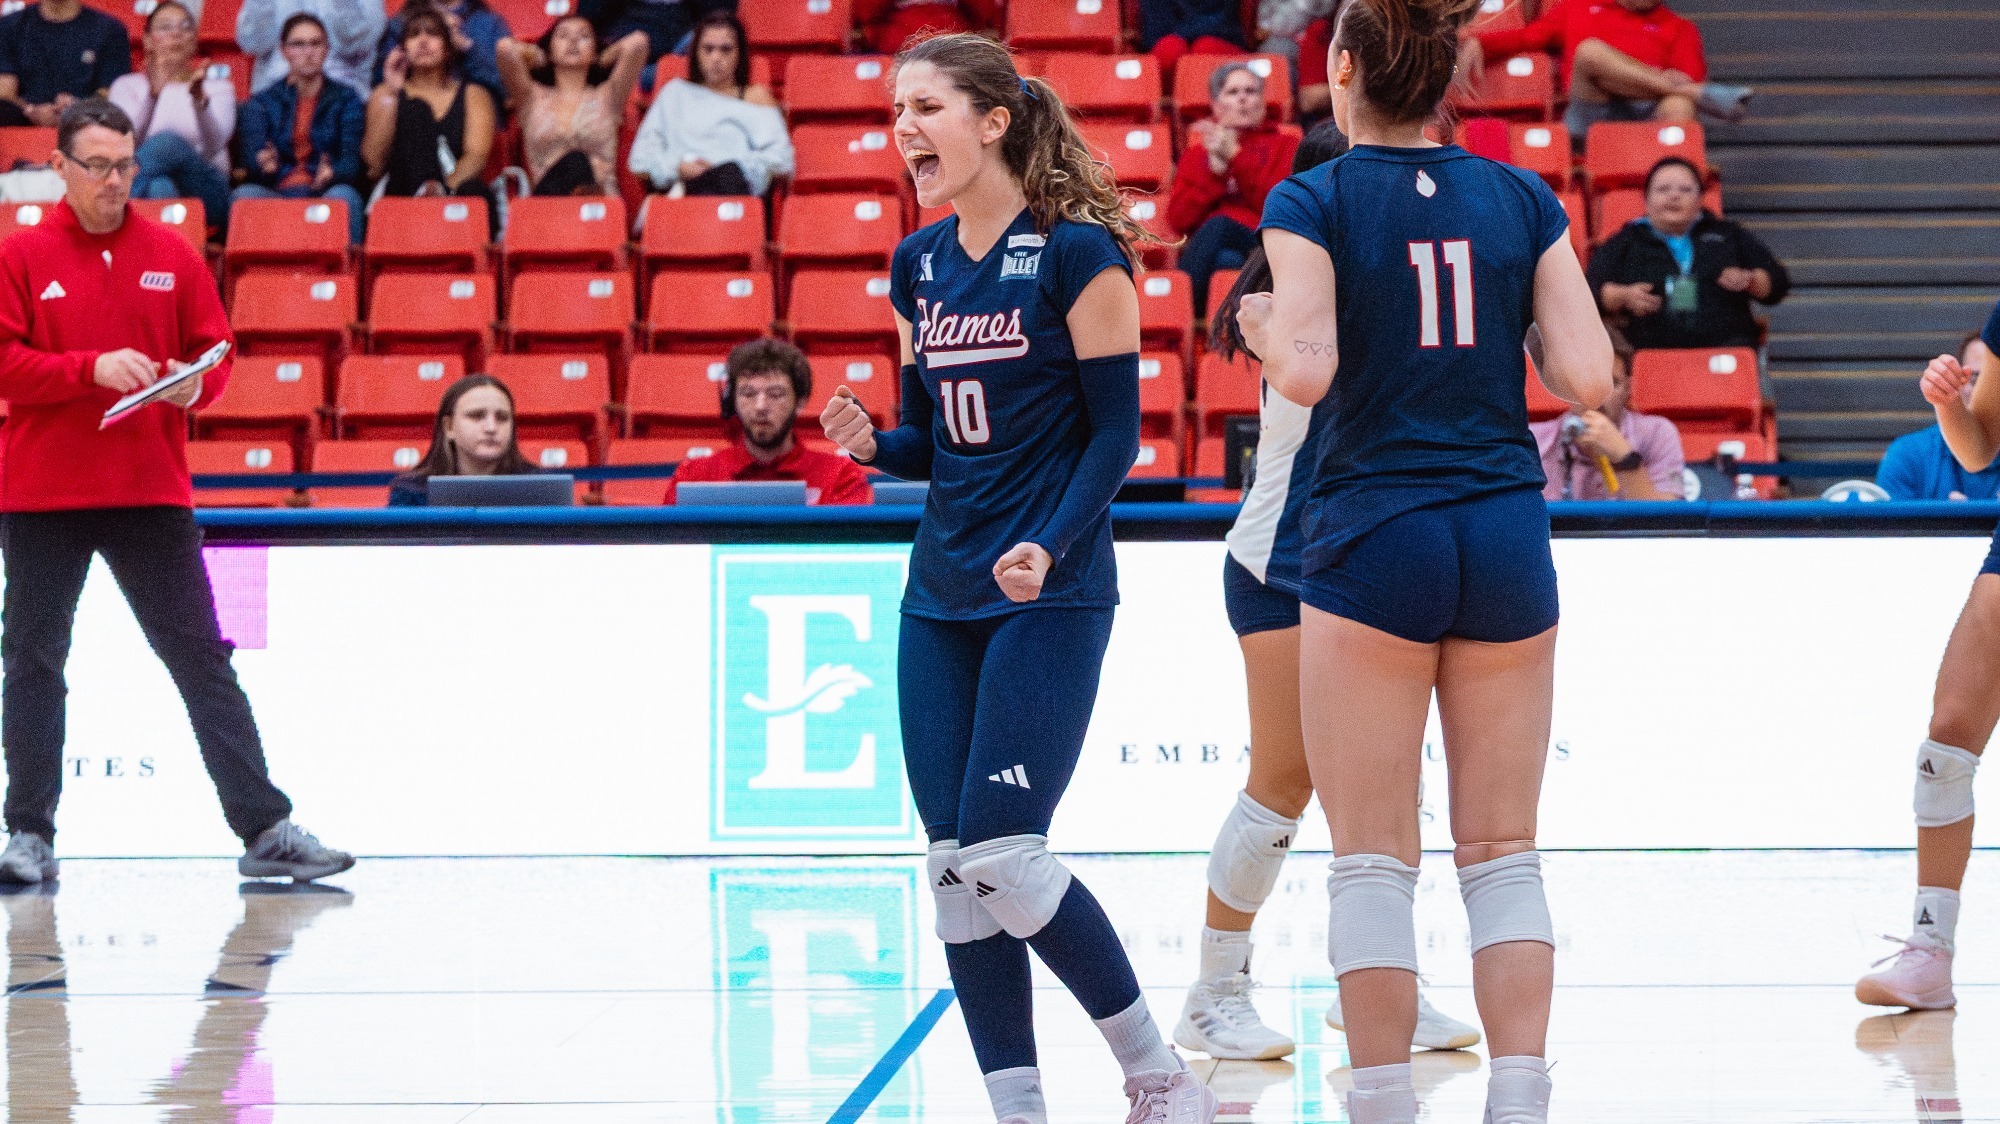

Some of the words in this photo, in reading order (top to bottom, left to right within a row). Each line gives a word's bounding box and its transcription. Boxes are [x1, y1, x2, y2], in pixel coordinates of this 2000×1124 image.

[1000, 250, 1042, 277] VALLEY
[1406, 239, 1475, 348] 11
[914, 297, 1029, 355] Flames
[940, 380, 990, 443] 10
[743, 594, 875, 789] E
[67, 757, 155, 777] TES
[1120, 744, 1250, 763] EMBA
